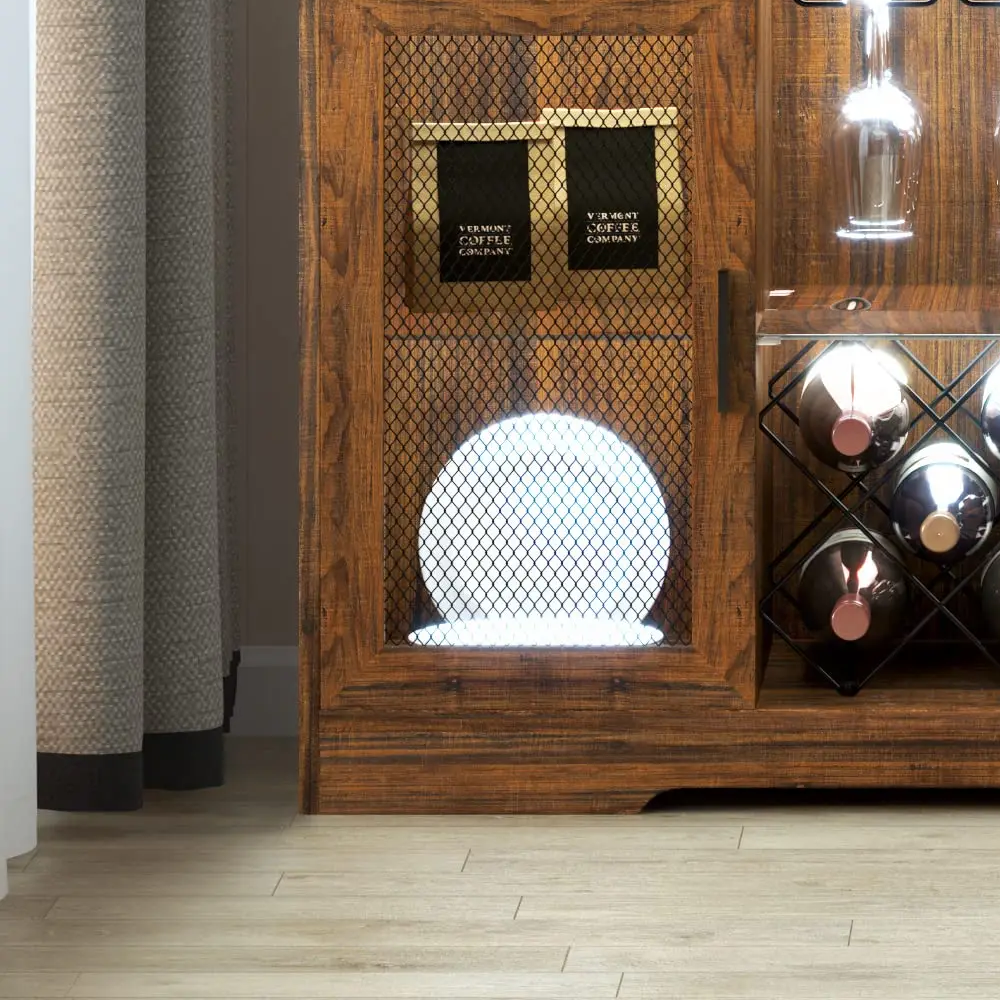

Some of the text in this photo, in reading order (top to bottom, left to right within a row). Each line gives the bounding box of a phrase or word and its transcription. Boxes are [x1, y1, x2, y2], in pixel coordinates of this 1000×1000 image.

[586, 222, 640, 233] COFFEE
[458, 235, 512, 246] COFFEE
[586, 235, 640, 244] COMPANY
[458, 247, 513, 256] COMPANY
